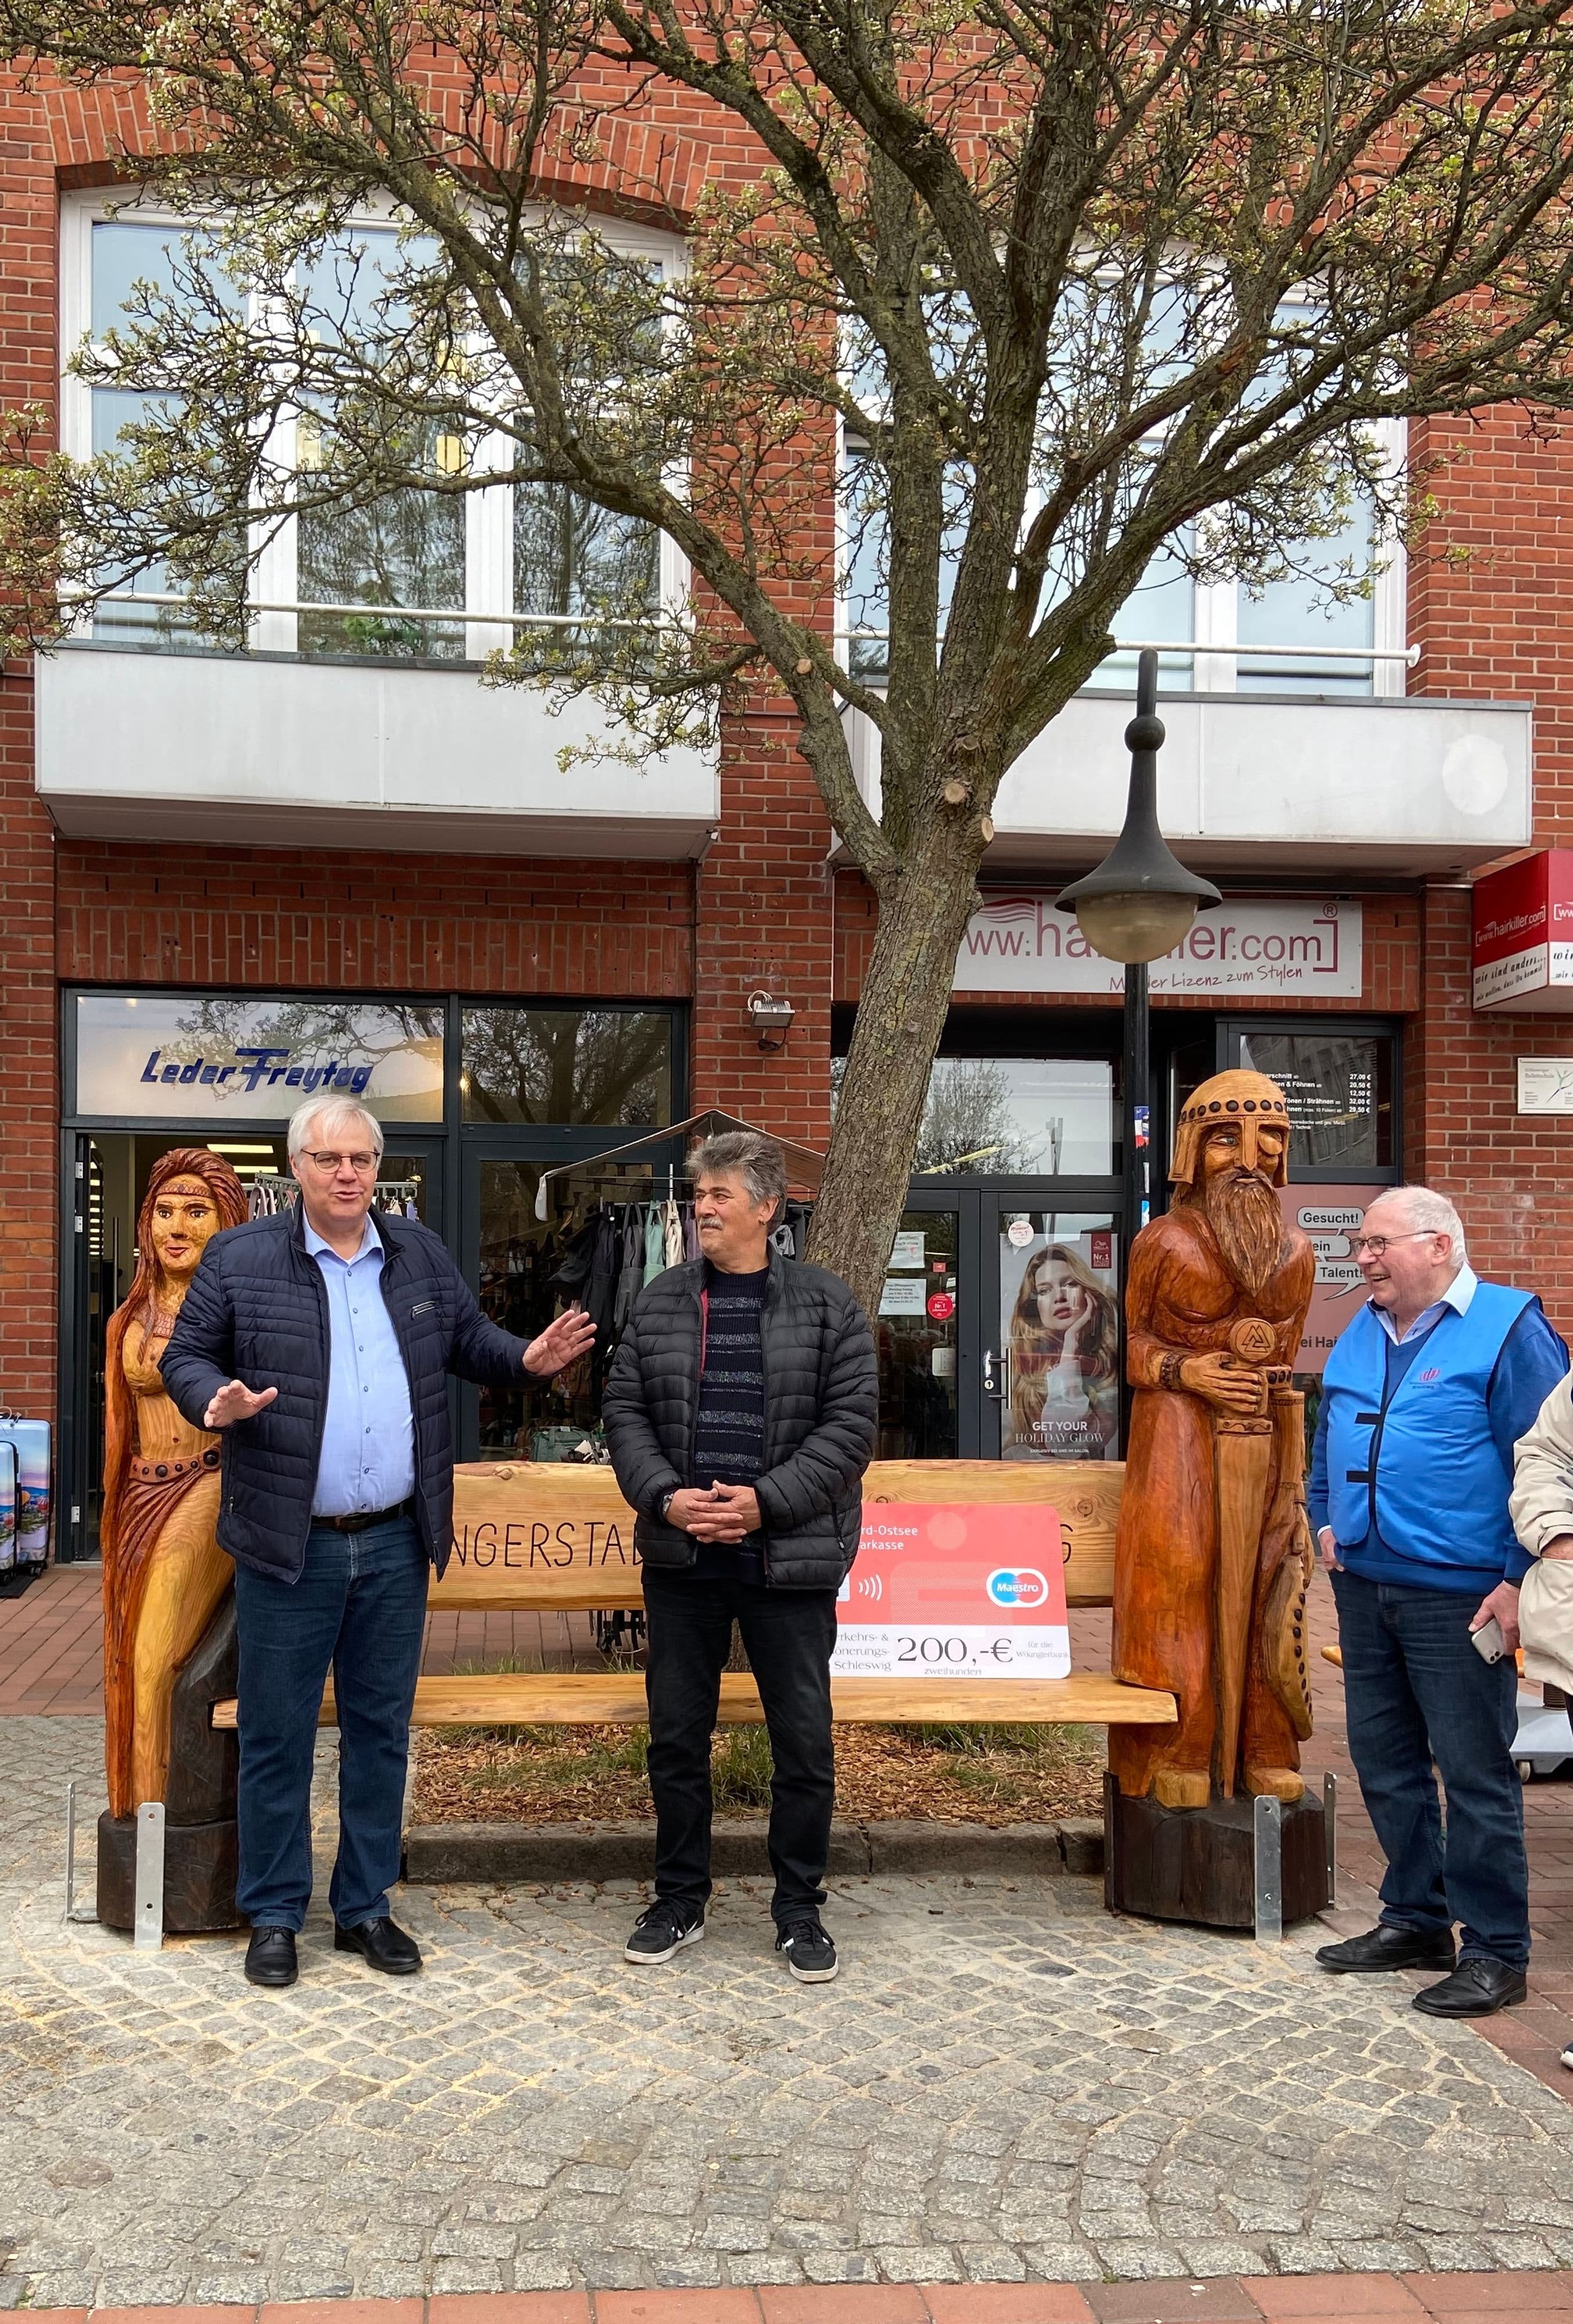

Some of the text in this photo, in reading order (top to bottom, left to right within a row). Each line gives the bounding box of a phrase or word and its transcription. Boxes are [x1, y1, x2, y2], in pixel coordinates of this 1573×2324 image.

[1171, 973, 1223, 987] Lizenz
[1227, 971, 1254, 983] zum
[1257, 963, 1303, 987] Stylen
[141, 1048, 373, 1093] Leder Freytag
[1303, 1212, 1359, 1224] Gesucht!
[1312, 1241, 1331, 1251] ein
[1320, 1267, 1363, 1279] Talent!
[1300, 1336, 1312, 1348] ei
[1032, 1421, 1088, 1431] GET YOUR
[1015, 1433, 1105, 1443] HOLIDAY GLOW
[861, 1525, 919, 1536] rd-Ostsee
[859, 1538, 905, 1550] arkasse
[997, 1581, 1039, 1593] Maestro
[838, 1631, 889, 1642] rkehrs- &
[1040, 1640, 1053, 1648] die
[833, 1647, 891, 1658] önerungs-
[1016, 1651, 1070, 1659] Wikingerbank
[834, 1660, 891, 1672] Schleswig
[924, 1666, 982, 1676] zweihundert
